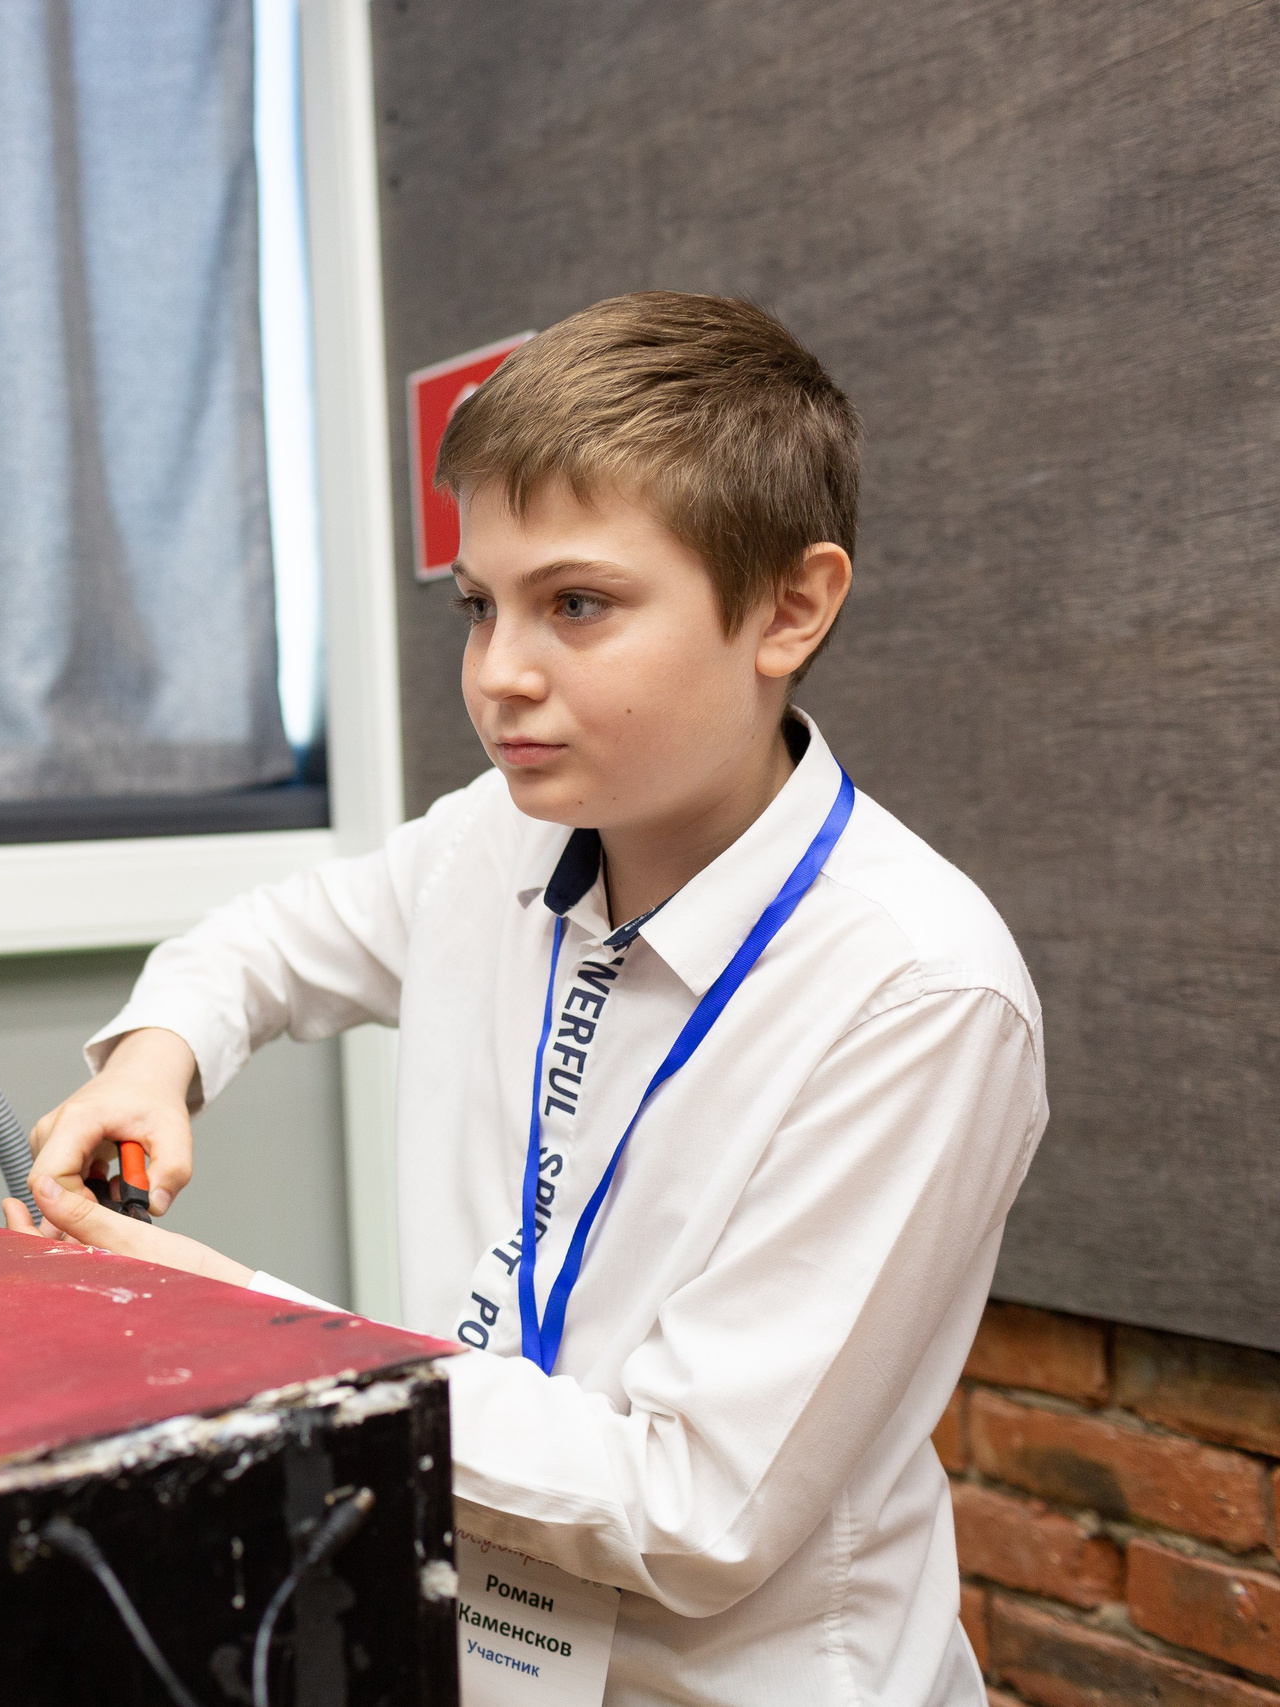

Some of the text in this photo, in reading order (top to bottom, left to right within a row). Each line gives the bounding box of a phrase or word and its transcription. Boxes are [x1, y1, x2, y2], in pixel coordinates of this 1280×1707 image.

[486, 1574, 555, 1613] Роман
[458, 1602, 572, 1657] Каменсков
[467, 1639, 540, 1678] Участник
